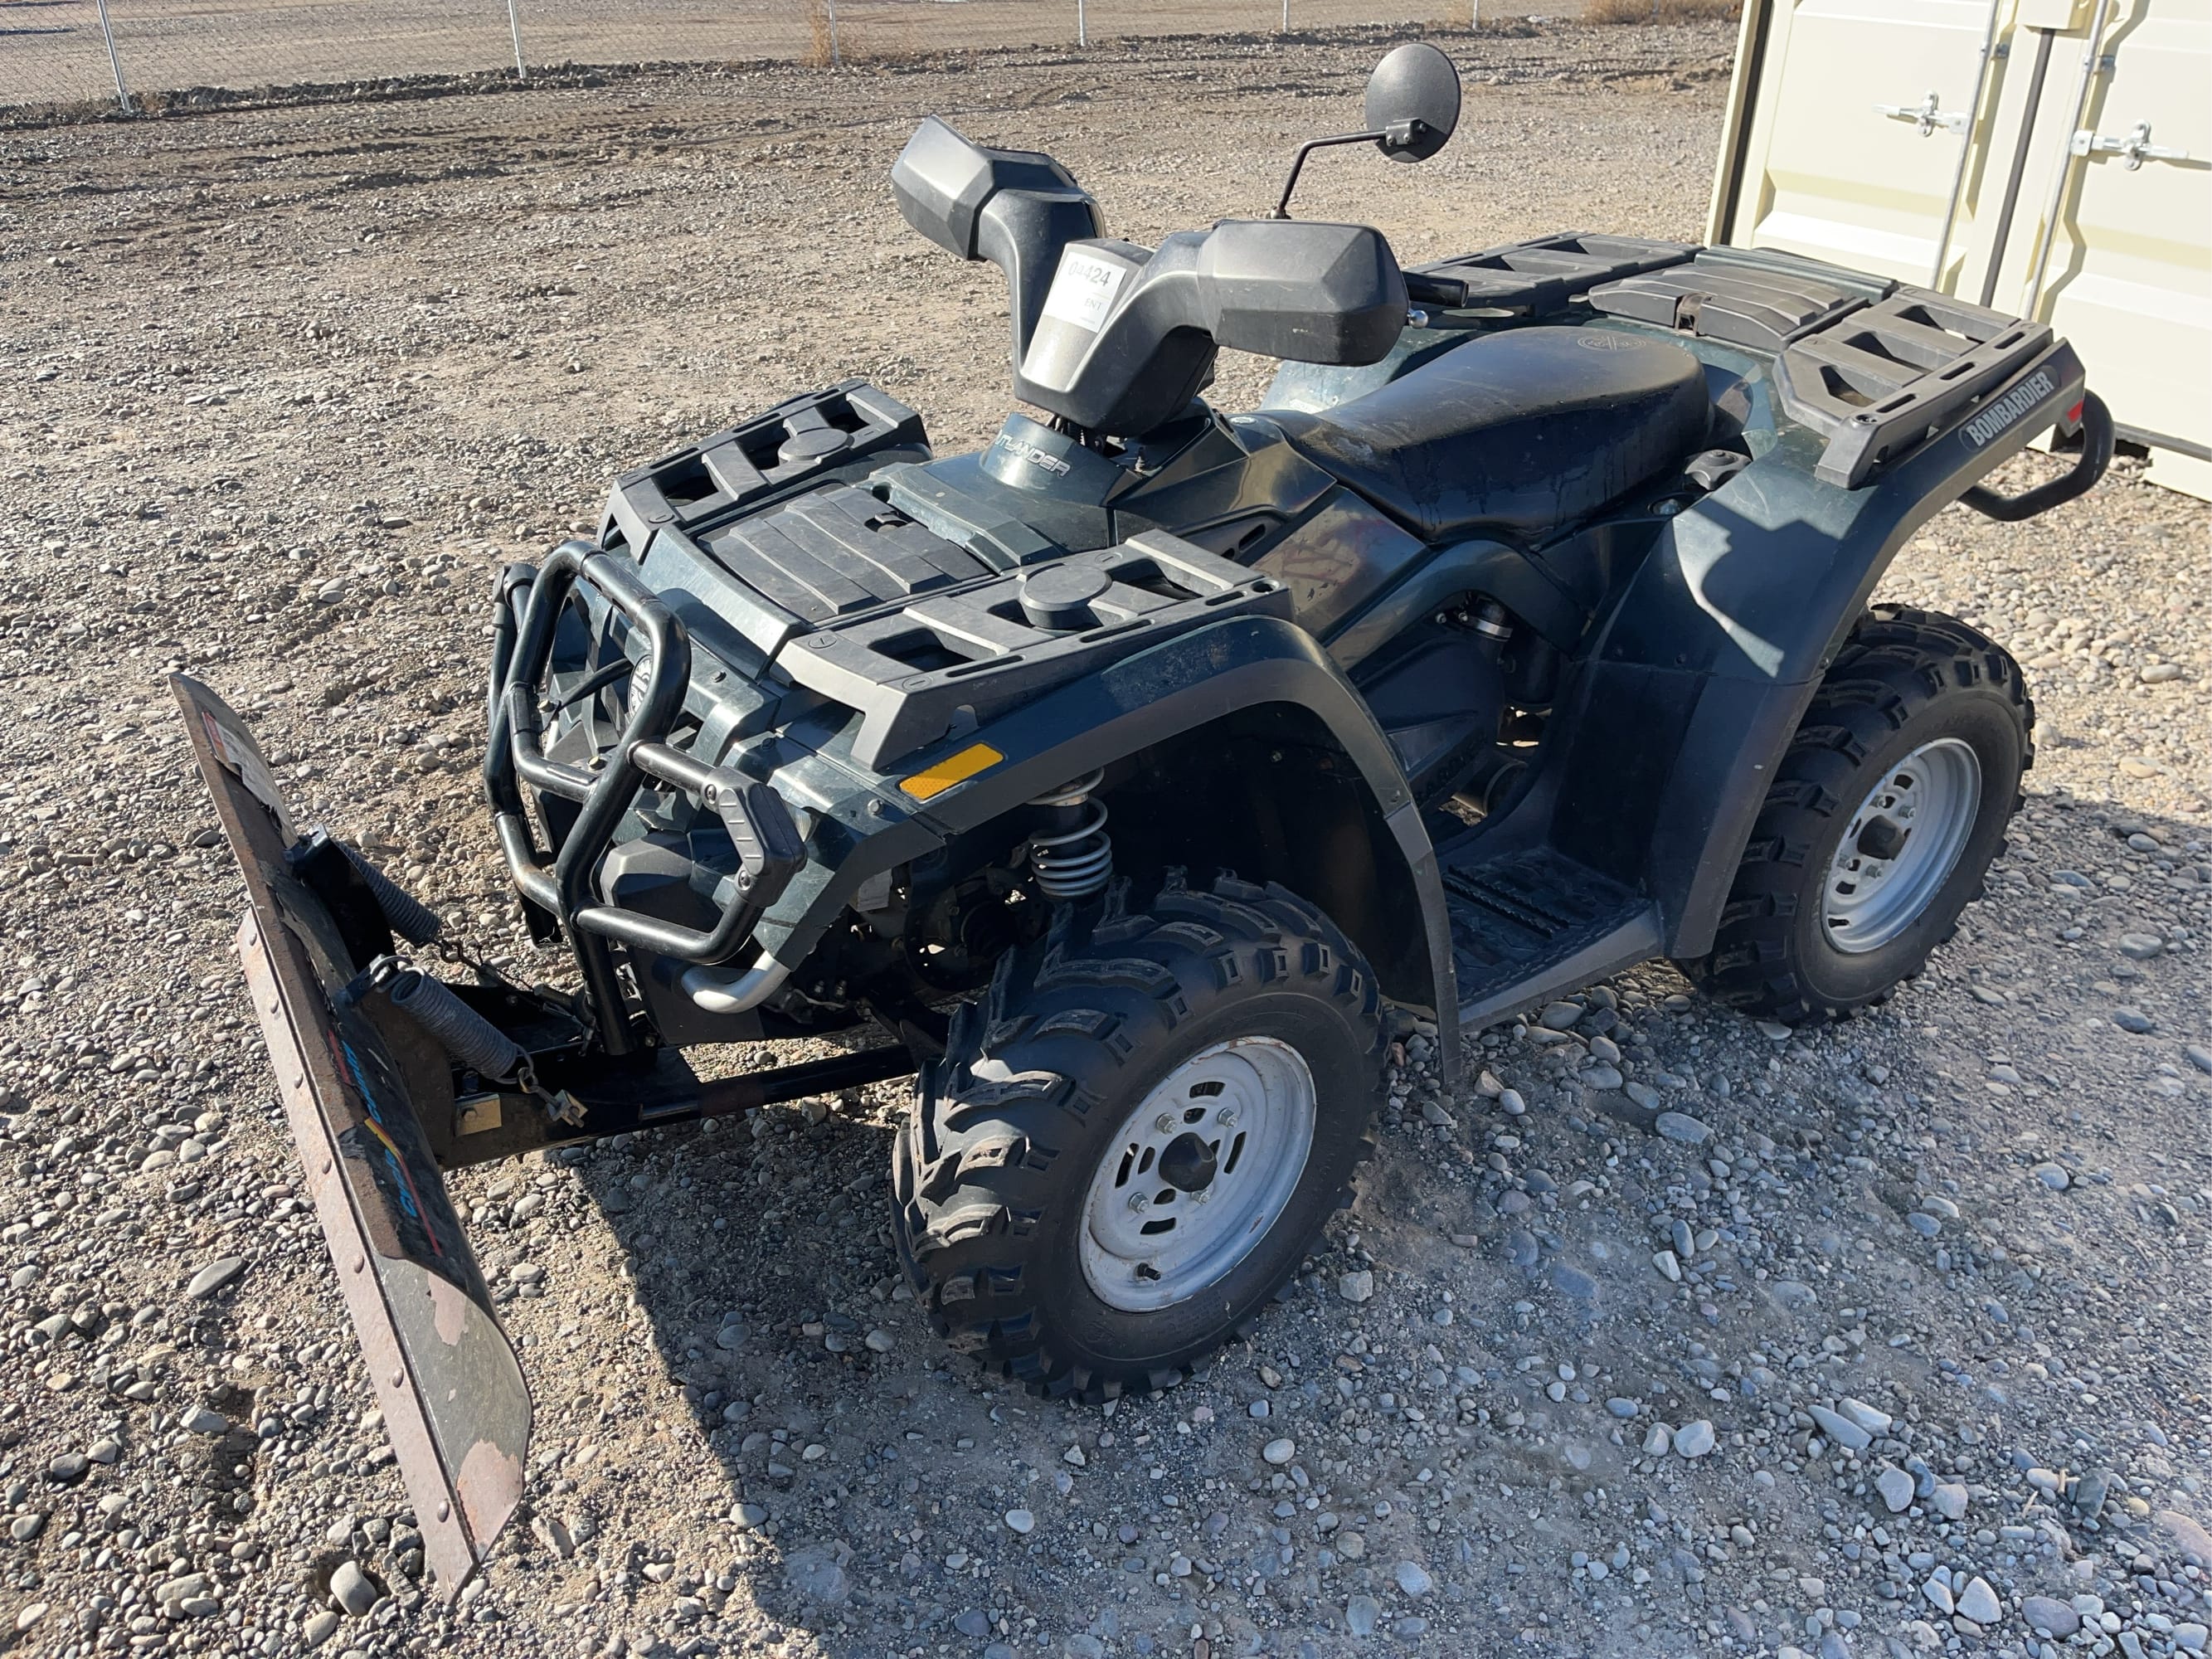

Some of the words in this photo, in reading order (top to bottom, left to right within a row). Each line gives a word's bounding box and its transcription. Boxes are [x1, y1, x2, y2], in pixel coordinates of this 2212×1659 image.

[1068, 260, 1111, 287] 04424
[1966, 371, 2054, 447] BOMBARDIER
[995, 430, 1072, 477] UTLANDER
[342, 1040, 382, 1123] Country
